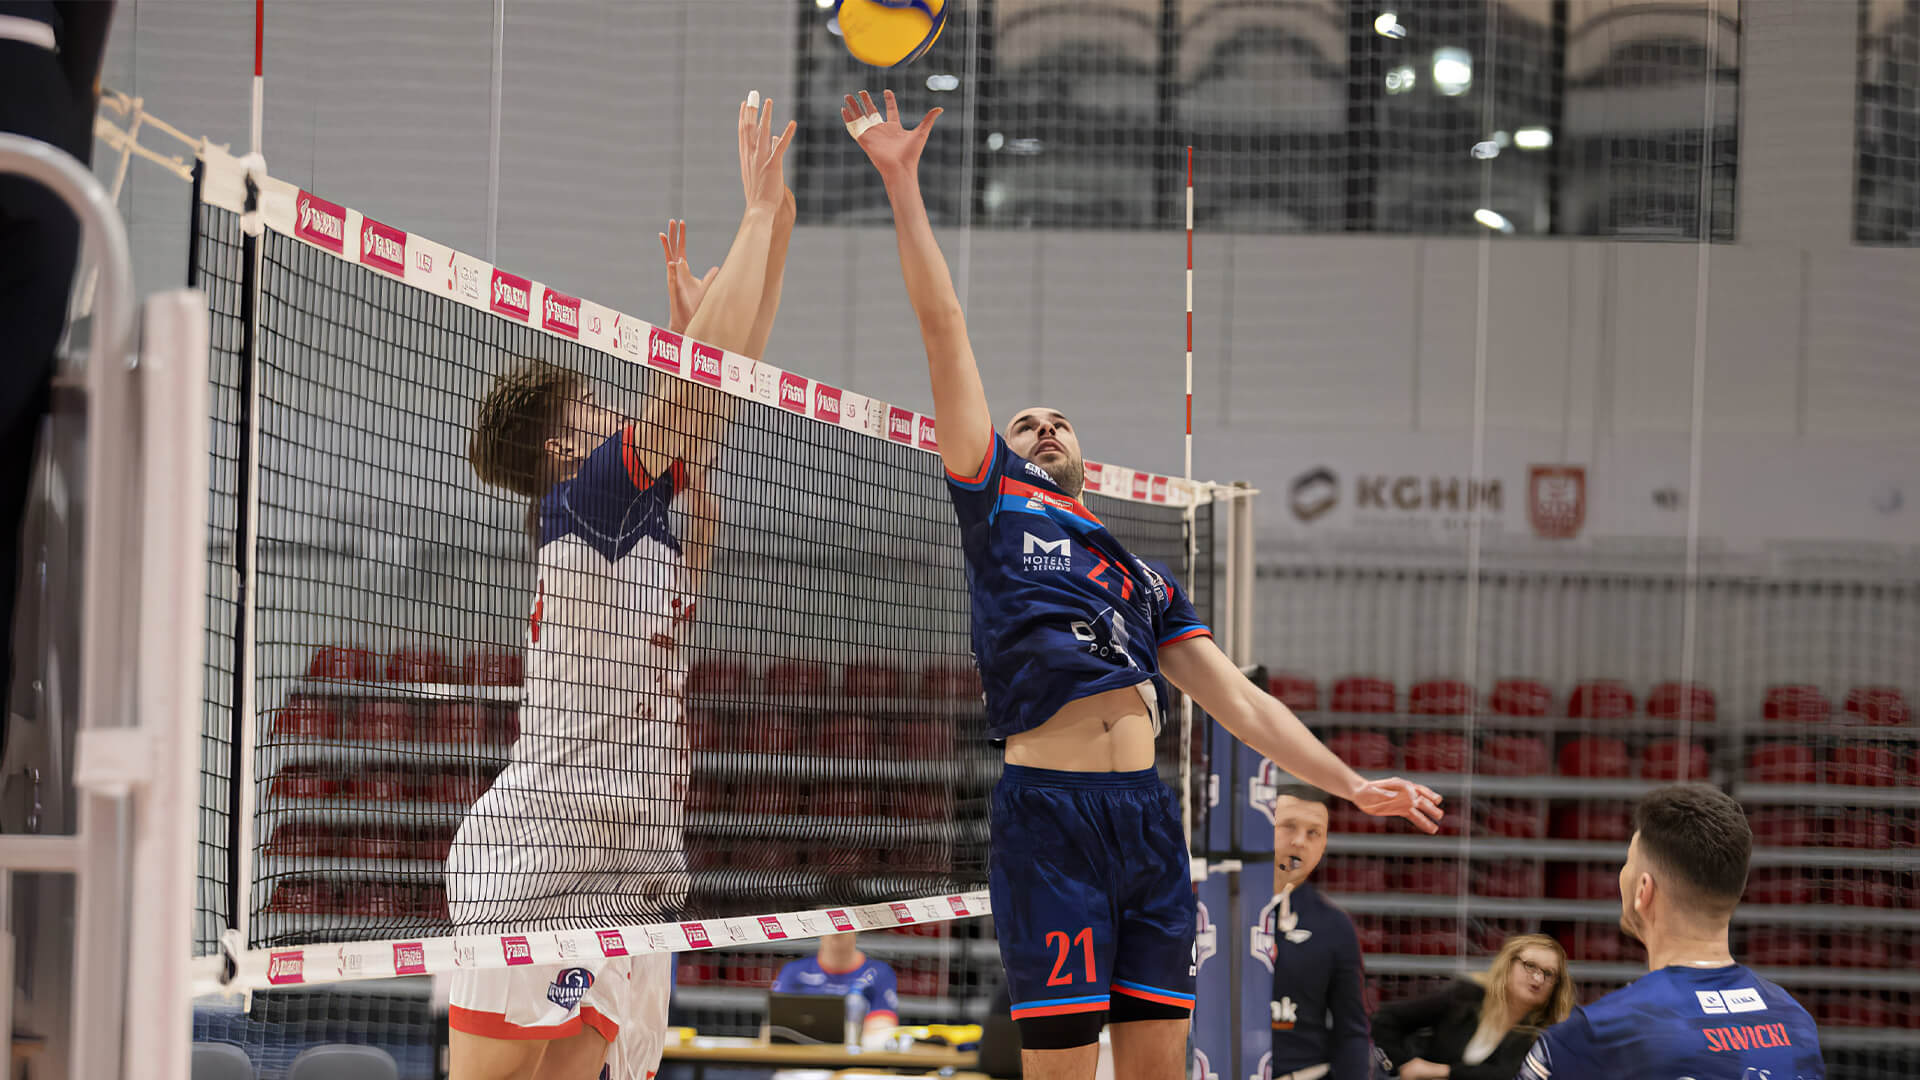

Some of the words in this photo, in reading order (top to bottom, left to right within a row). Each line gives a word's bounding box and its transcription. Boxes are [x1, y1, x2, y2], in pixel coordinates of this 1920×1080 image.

[1355, 475, 1503, 510] KGHM
[1023, 556, 1071, 567] HOTELS
[1045, 927, 1097, 987] 21
[1702, 1022, 1792, 1052] SIWICKI
